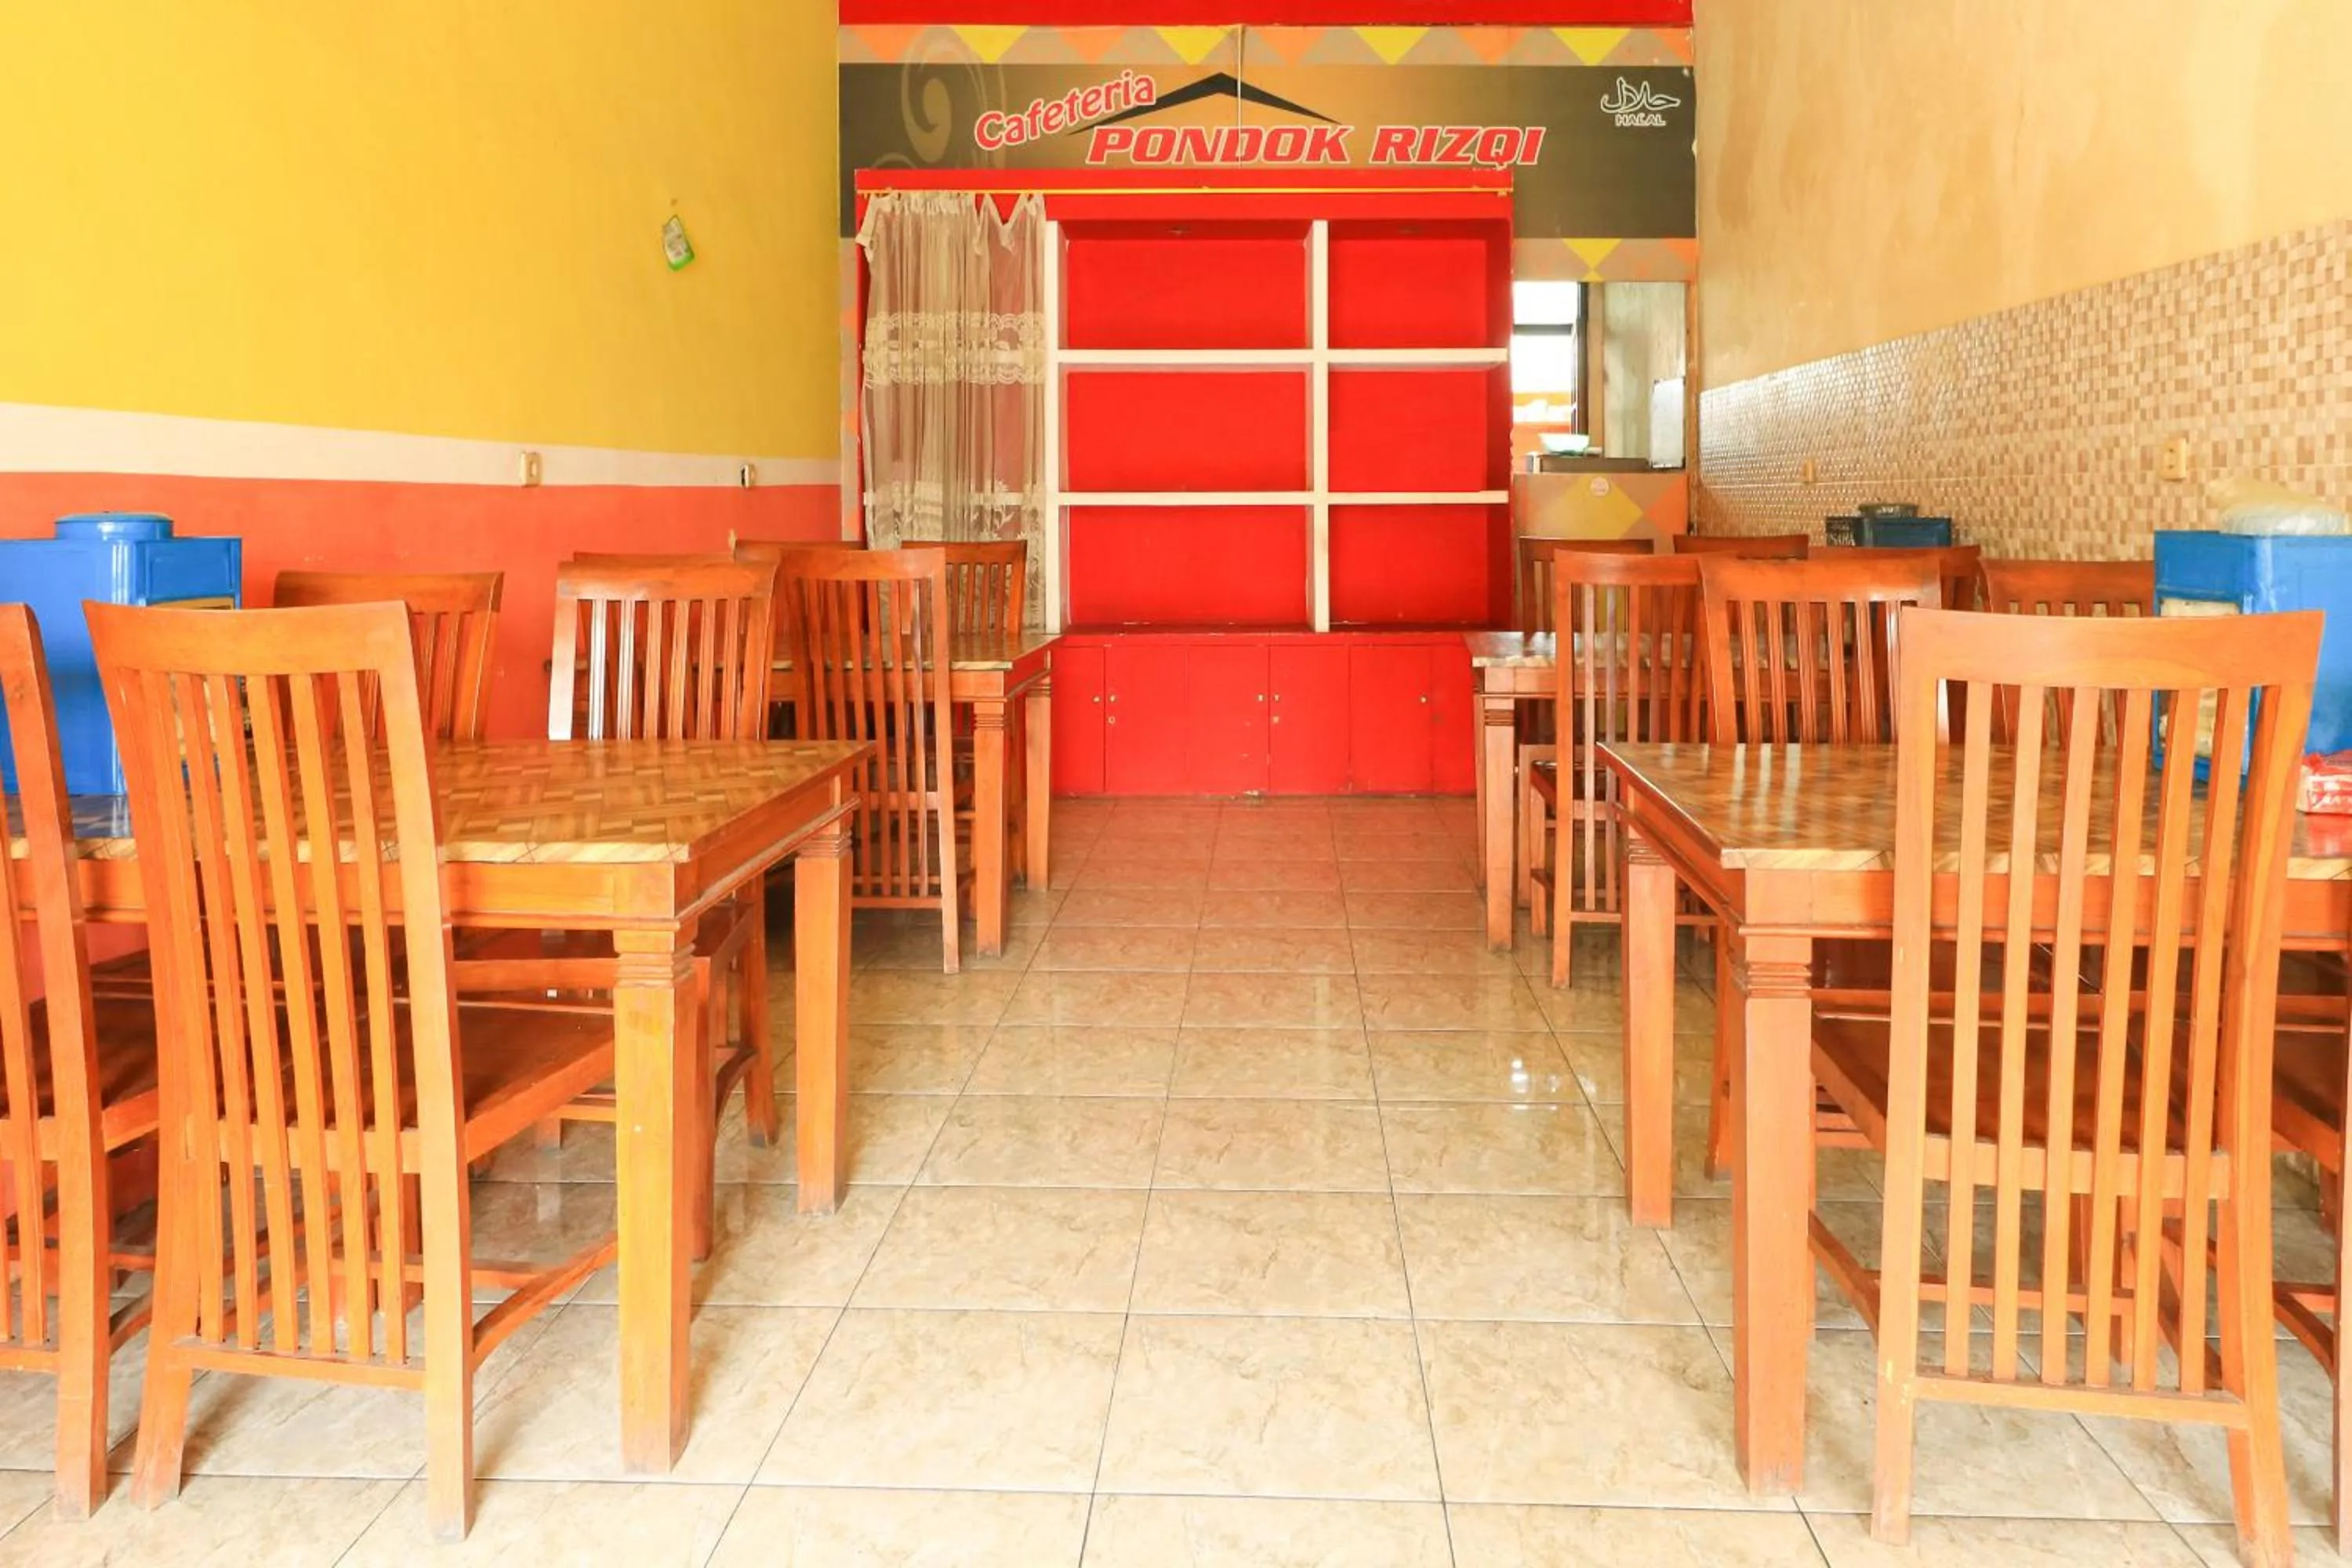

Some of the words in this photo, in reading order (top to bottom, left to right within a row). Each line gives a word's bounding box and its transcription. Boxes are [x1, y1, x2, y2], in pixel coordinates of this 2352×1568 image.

[975, 69, 1156, 151] Cafeteria
[1615, 113, 1667, 126] HALAL
[1085, 125, 1355, 165] PONDOK
[1370, 126, 1546, 169] RIZQI
